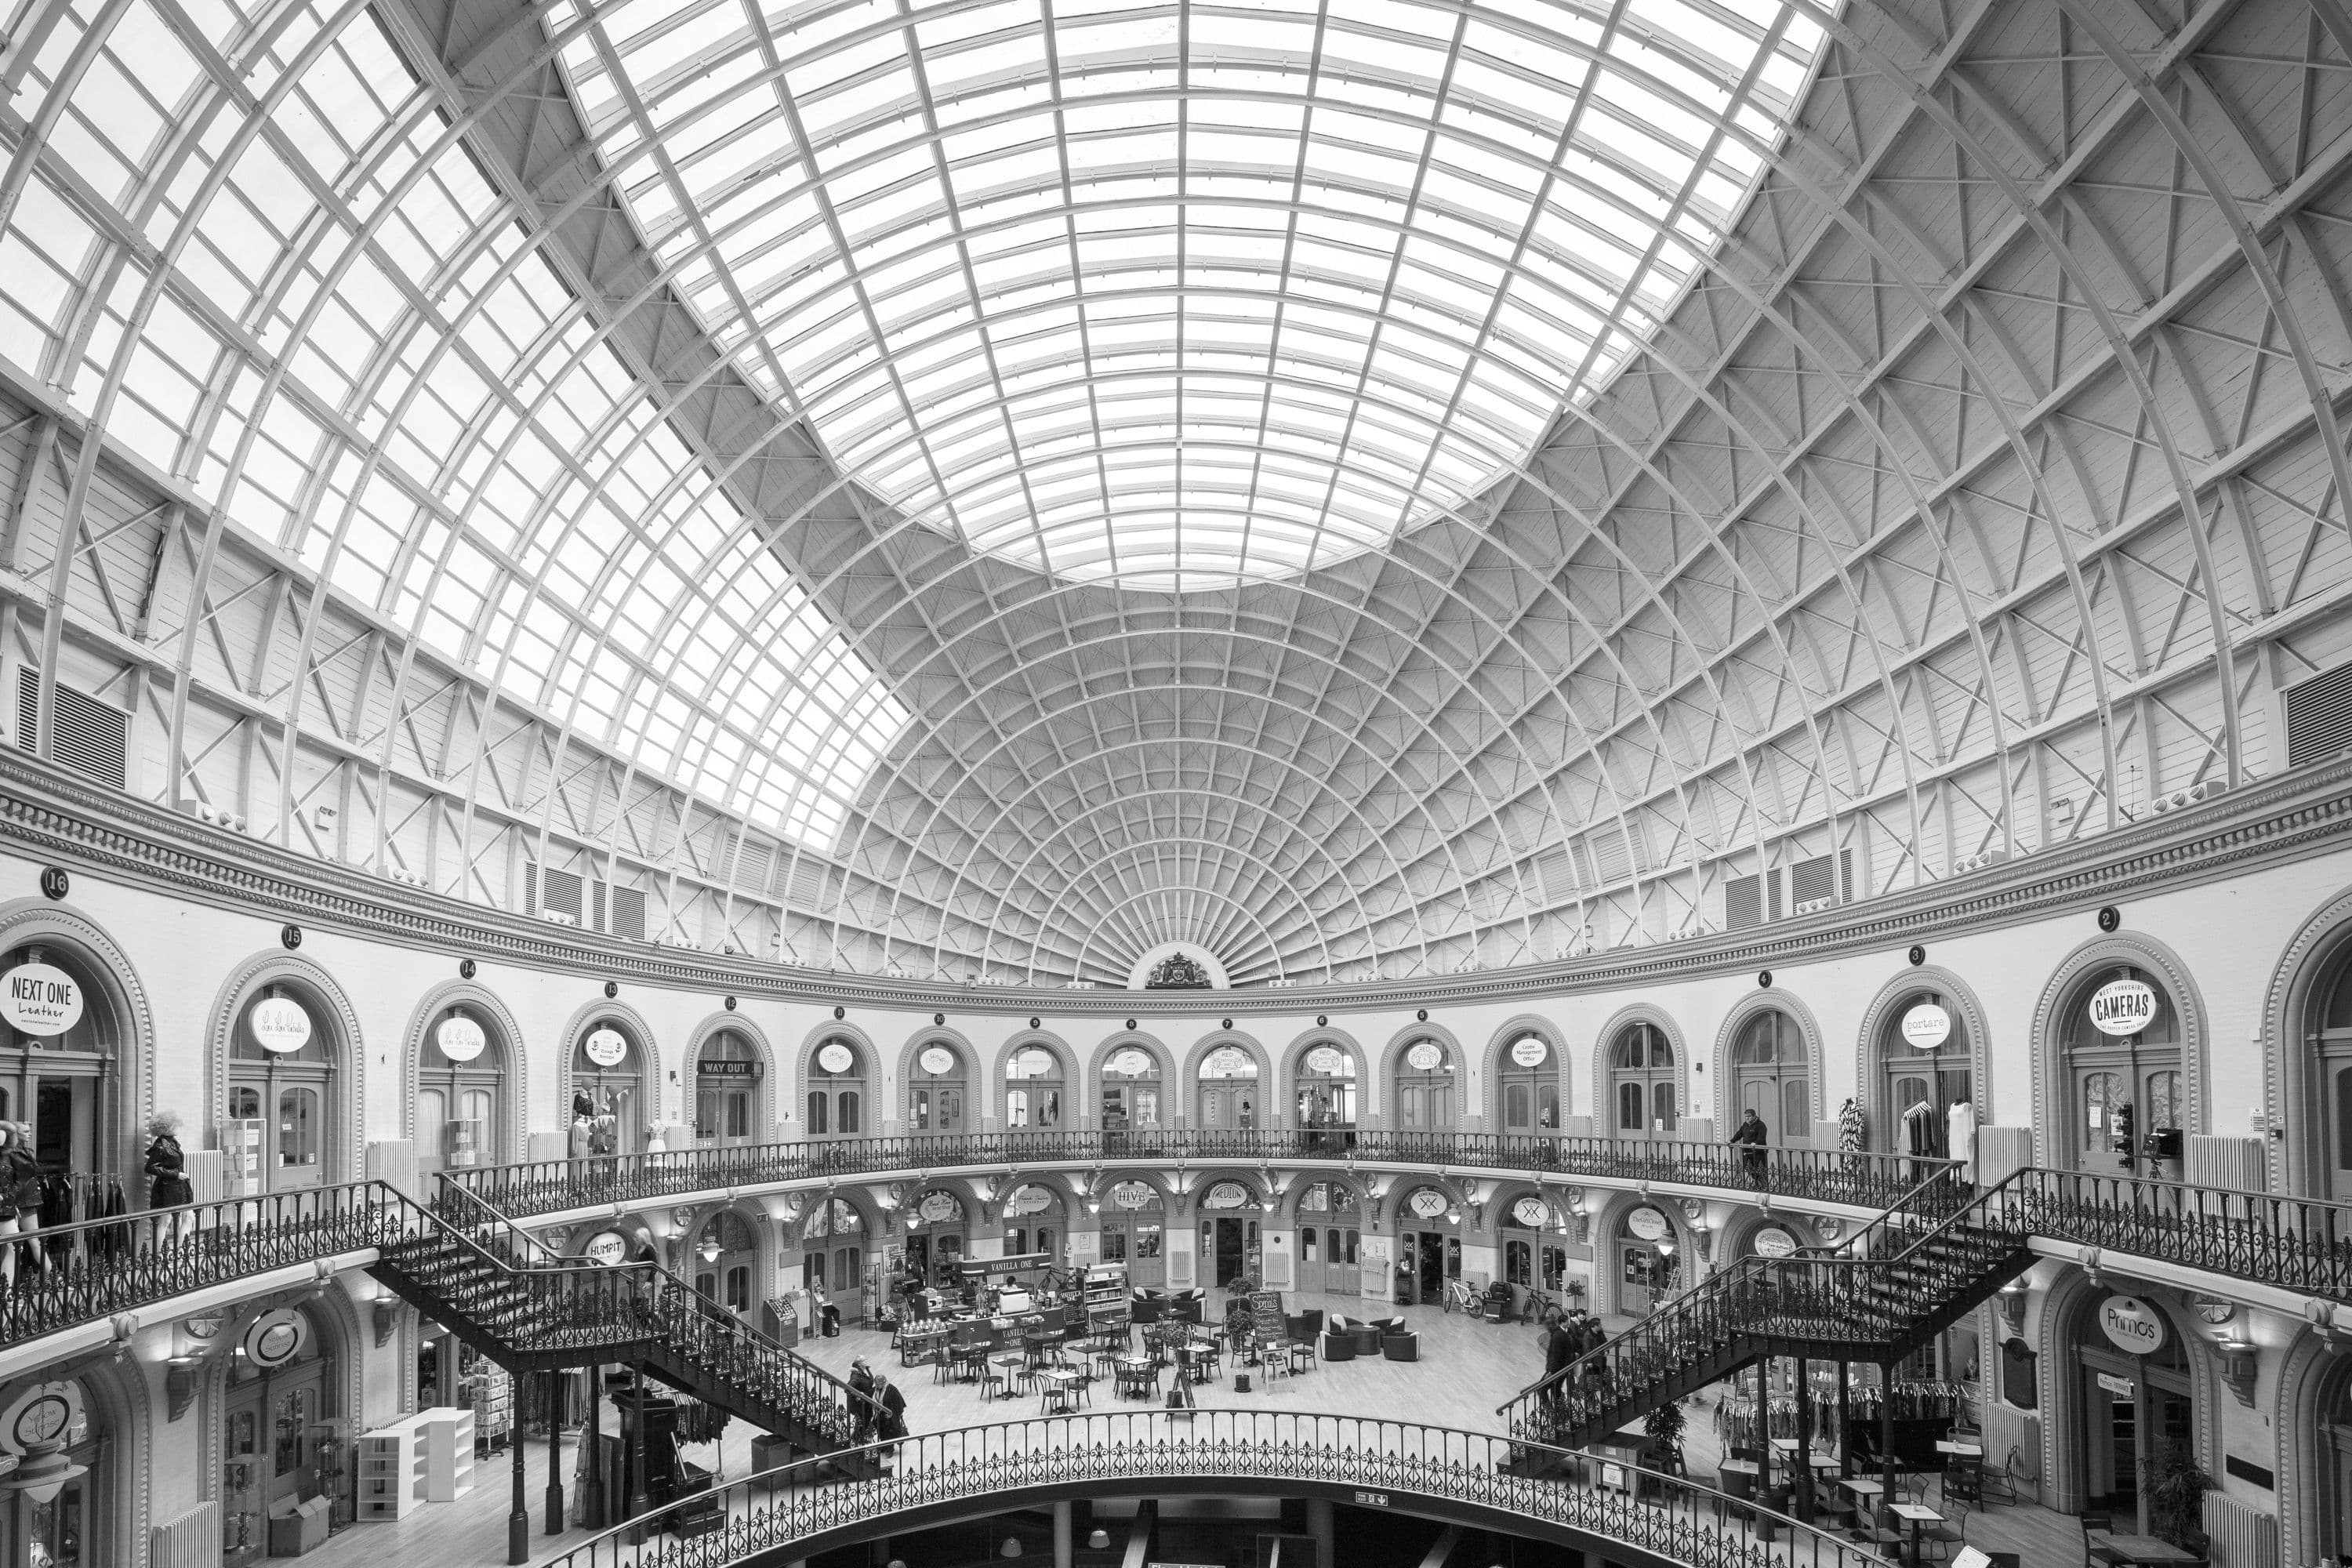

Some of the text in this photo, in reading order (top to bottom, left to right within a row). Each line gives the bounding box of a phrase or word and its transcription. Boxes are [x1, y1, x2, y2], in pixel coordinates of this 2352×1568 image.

[49, 872, 67, 891] 16
[2102, 913, 2111, 926] 2
[288, 928, 300, 943] 15
[1913, 949, 1919, 960] 3
[465, 962, 475, 975] 14
[1761, 974, 1767, 983] 4
[12, 977, 72, 1006] NEXT ONE
[608, 984, 617, 994] 13
[2099, 985, 2144, 997] WEST YORKSHIRE
[727, 999, 735, 1007] 12
[2096, 994, 2149, 1022] CAMERAS
[18, 1002, 64, 1018] Leather
[1907, 1018, 1944, 1033] portare
[705, 1063, 746, 1073] WAY OUT
[1118, 1191, 1145, 1202] HIVE
[1215, 1186, 1242, 1199] MEDIUM
[590, 1241, 622, 1257] HUMPIT
[991, 1260, 1033, 1272] VANILLA ONE
[1002, 1328, 1025, 1338] VANILL
[1009, 1338, 1022, 1347] ONE
